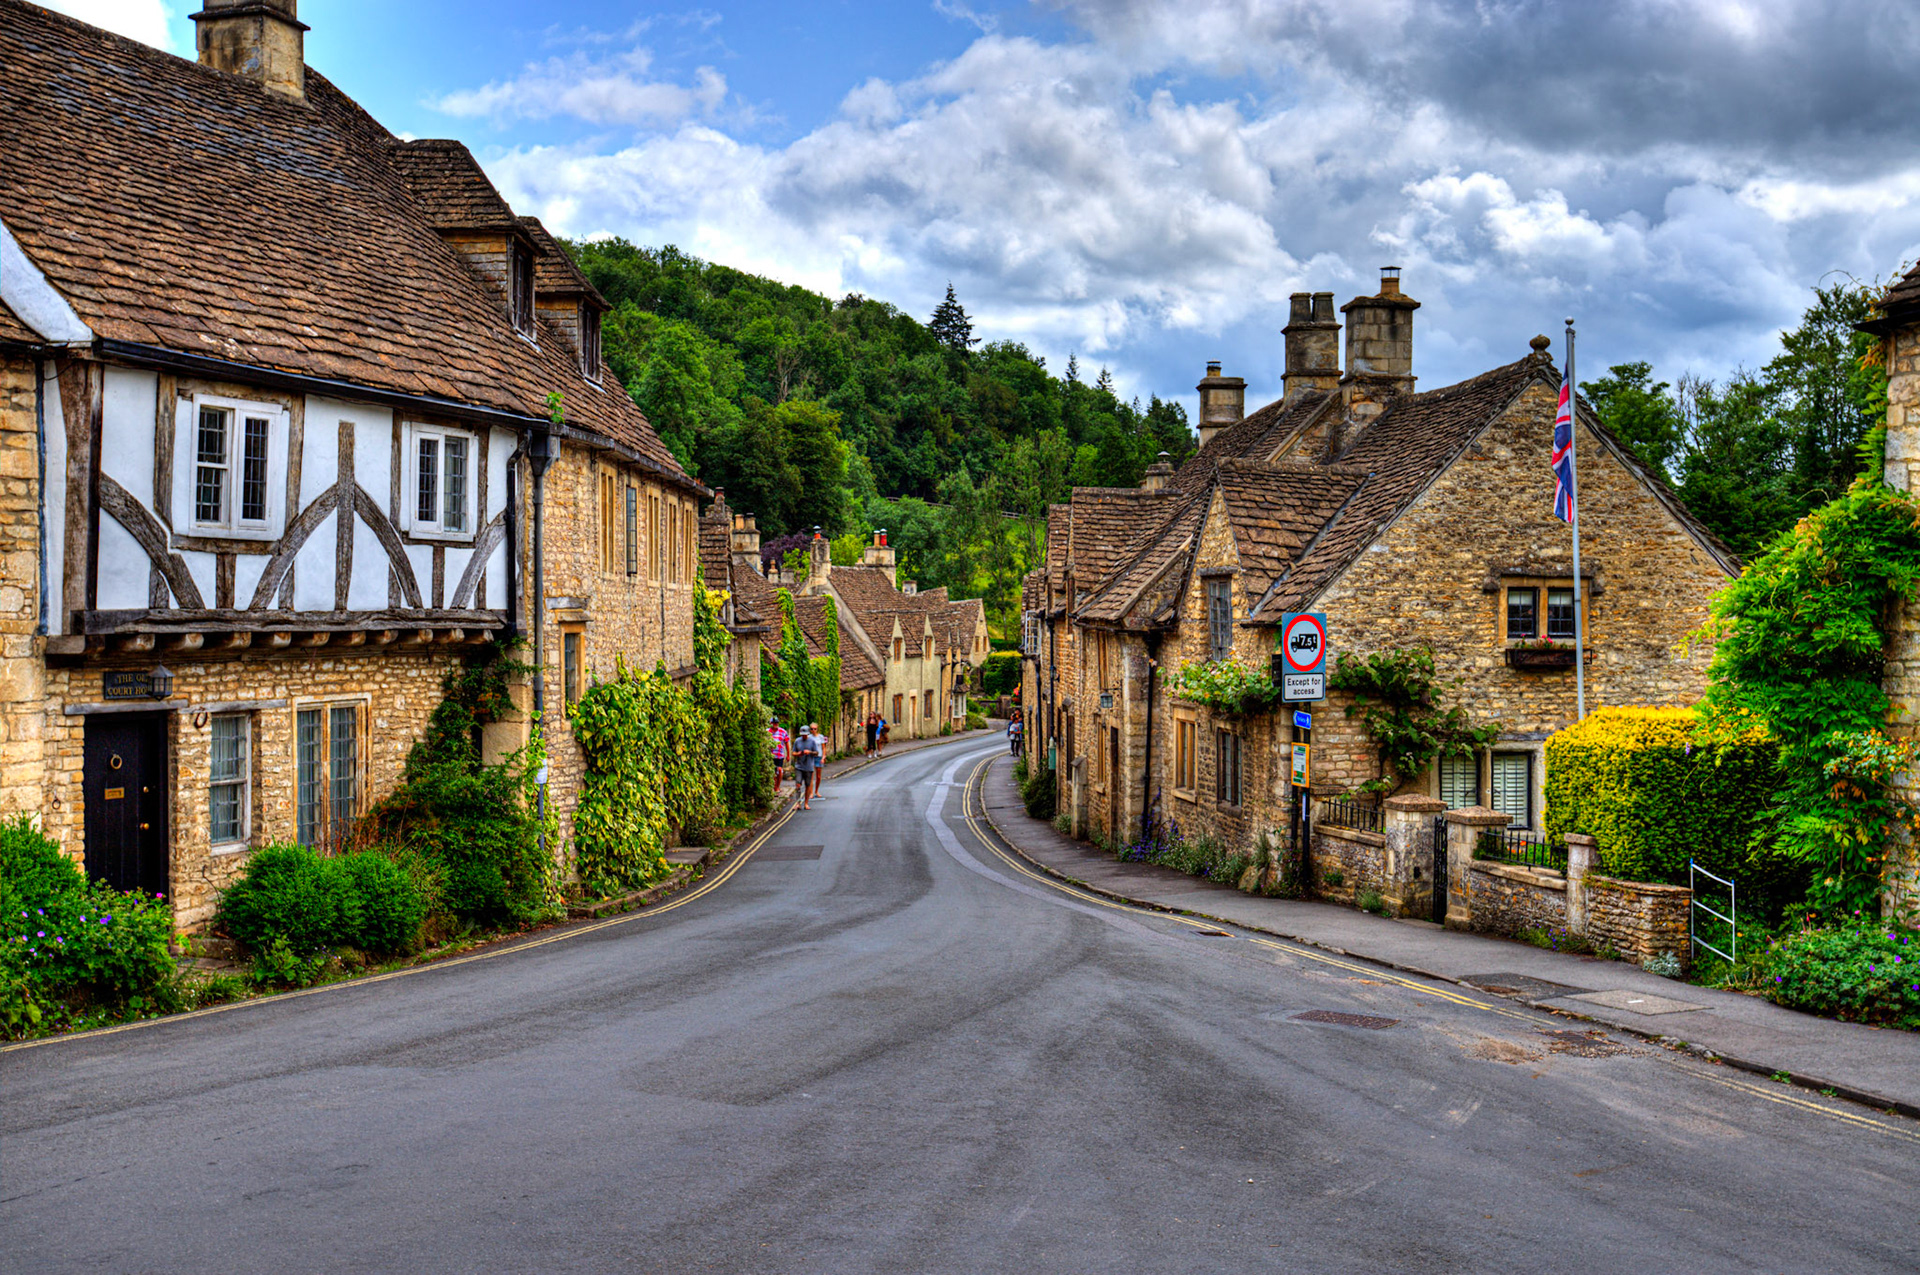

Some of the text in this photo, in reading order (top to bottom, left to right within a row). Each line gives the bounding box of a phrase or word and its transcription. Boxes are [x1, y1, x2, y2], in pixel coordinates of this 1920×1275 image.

[116, 674, 148, 684] THE OL
[1287, 678, 1310, 686] Except
[108, 686, 148, 696] COURT HO
